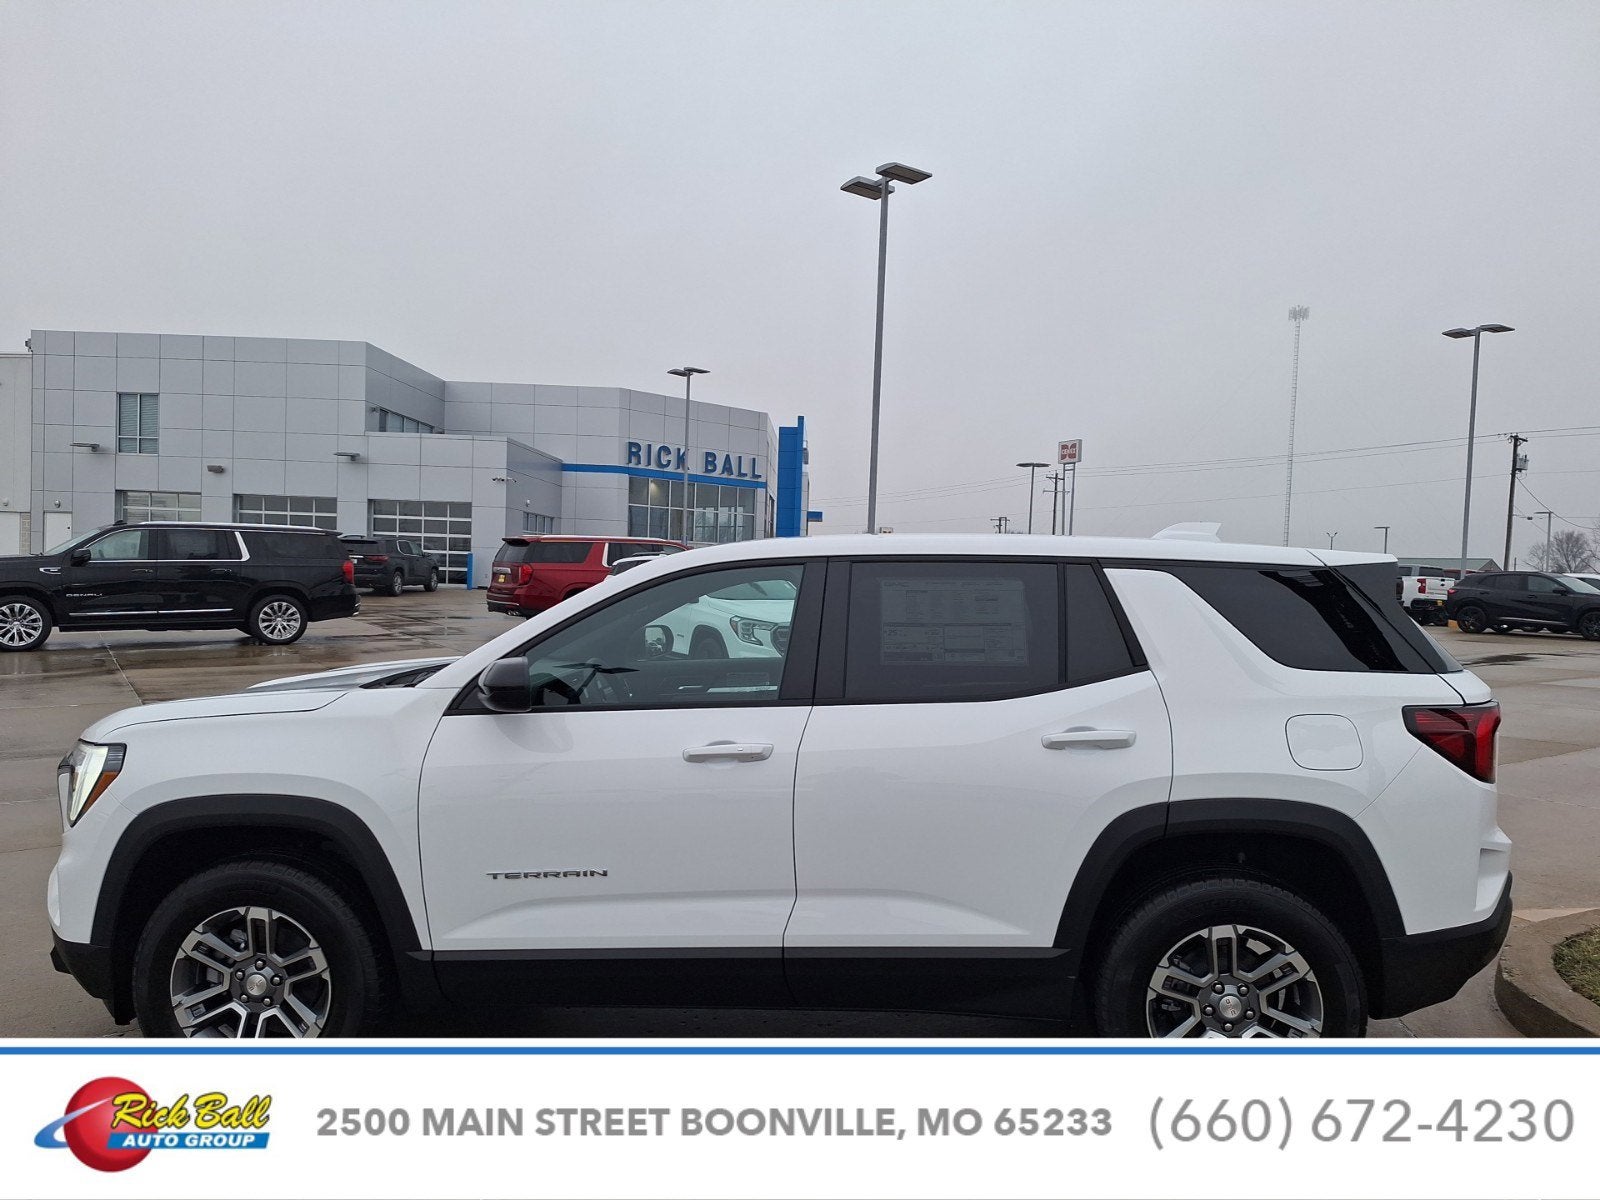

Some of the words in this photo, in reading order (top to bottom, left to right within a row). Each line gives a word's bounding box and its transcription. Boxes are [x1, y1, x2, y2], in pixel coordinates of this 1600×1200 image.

[627, 441, 690, 471] RICK
[703, 451, 762, 479] BALL
[486, 869, 608, 880] TERRAIN
